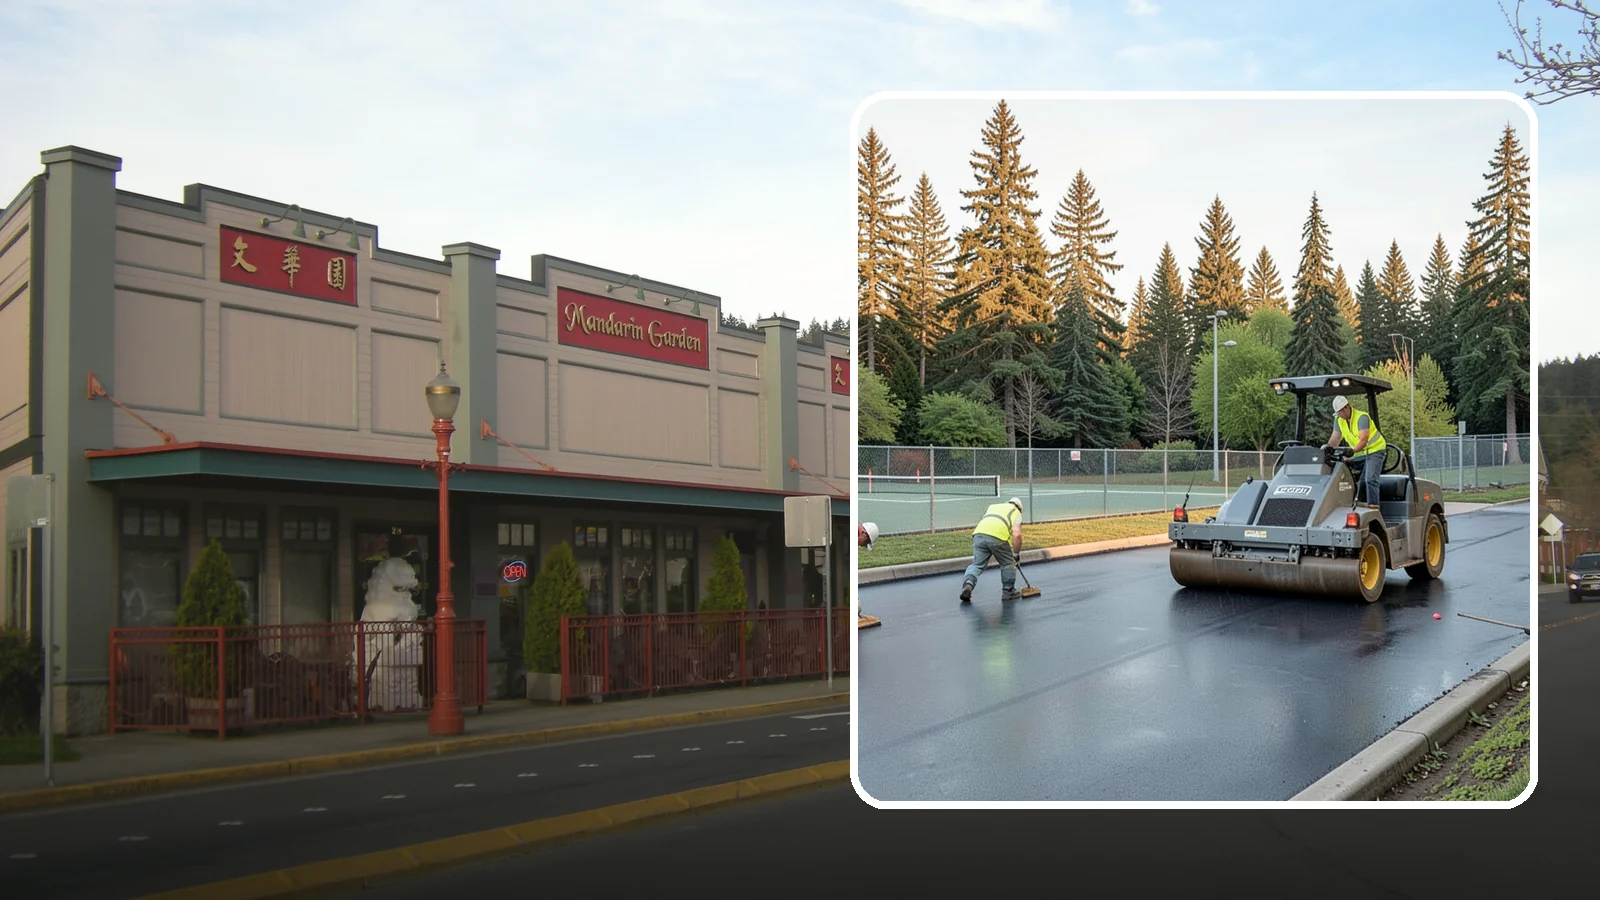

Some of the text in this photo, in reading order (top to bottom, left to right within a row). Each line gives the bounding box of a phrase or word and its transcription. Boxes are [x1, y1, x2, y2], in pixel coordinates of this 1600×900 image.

[231, 235, 347, 291] 文華園
[564, 302, 702, 352] Mandarin Garden
[503, 565, 527, 578] OPEN
